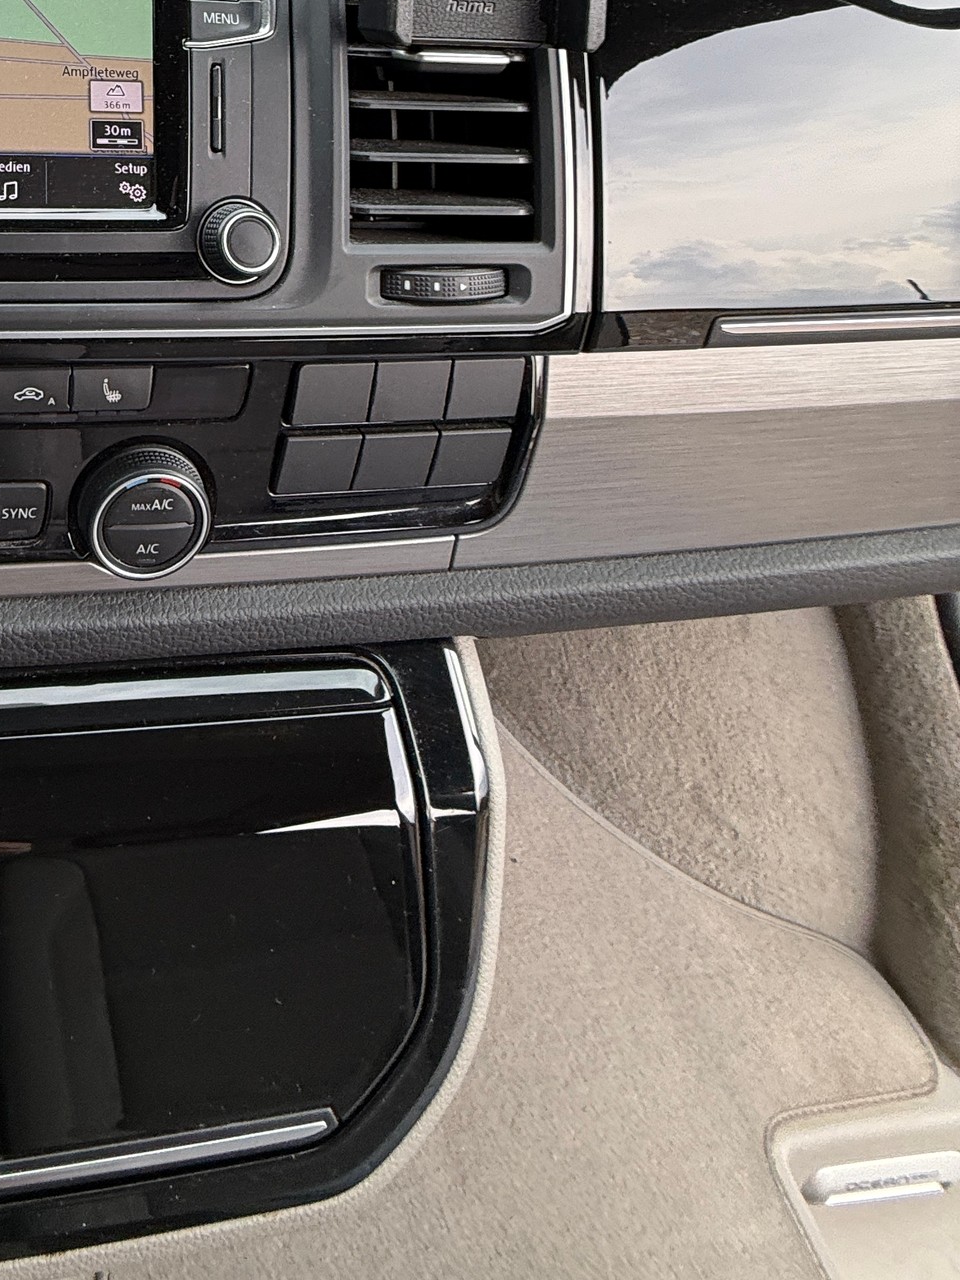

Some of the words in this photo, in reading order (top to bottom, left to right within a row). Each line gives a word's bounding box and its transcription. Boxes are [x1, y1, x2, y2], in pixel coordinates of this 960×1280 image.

[203, 11, 240, 25] MENU
[62, 65, 139, 80] Ampfleteweg
[114, 162, 148, 177] Setup
[47, 397, 56, 406] A
[1, 507, 37, 520] SYNC
[135, 543, 160, 554] A/C
